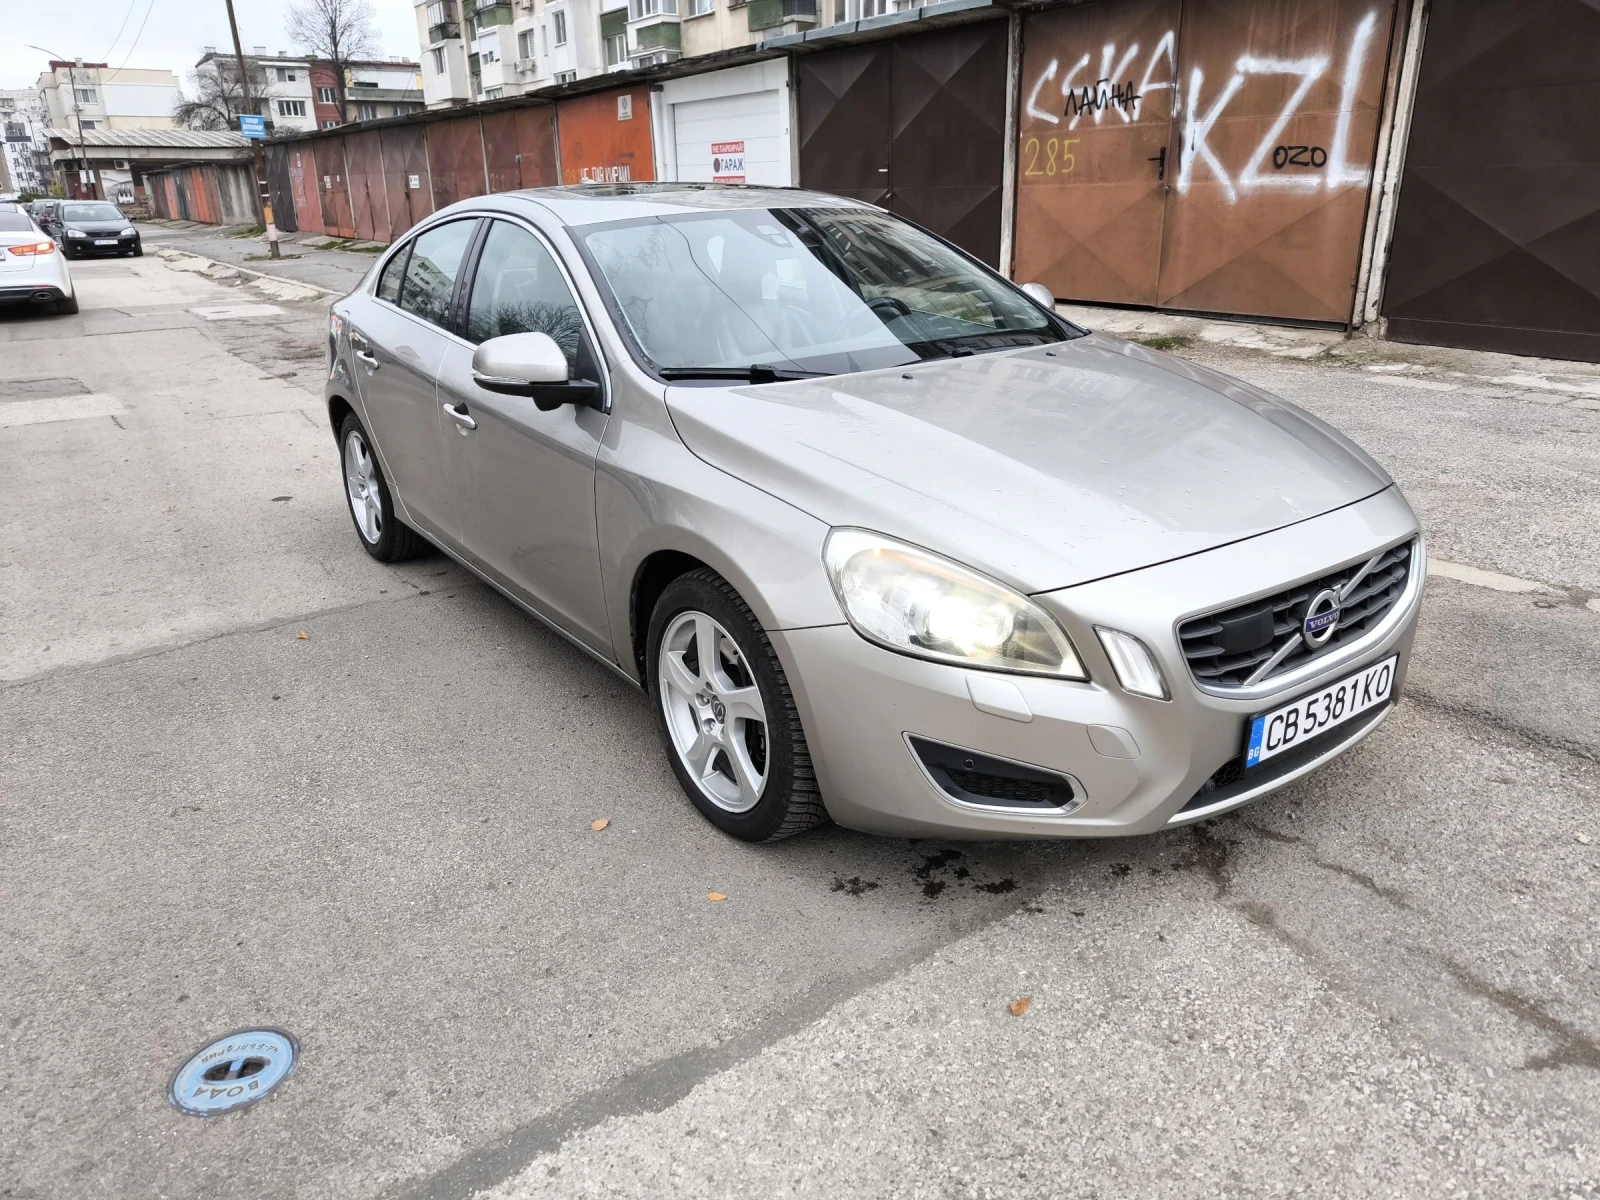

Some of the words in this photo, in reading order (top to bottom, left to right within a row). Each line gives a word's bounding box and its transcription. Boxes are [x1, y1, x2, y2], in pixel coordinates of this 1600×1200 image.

[1063, 78, 1142, 117] ЛАЙНА
[713, 145, 720, 153] НЕ
[1024, 138, 1080, 176] 285
[720, 158, 744, 171] ГАРАЖ
[1308, 611, 1340, 629] VOLVO
[1247, 746, 1260, 761] BG
[193, 1080, 259, 1099] ВОДА
